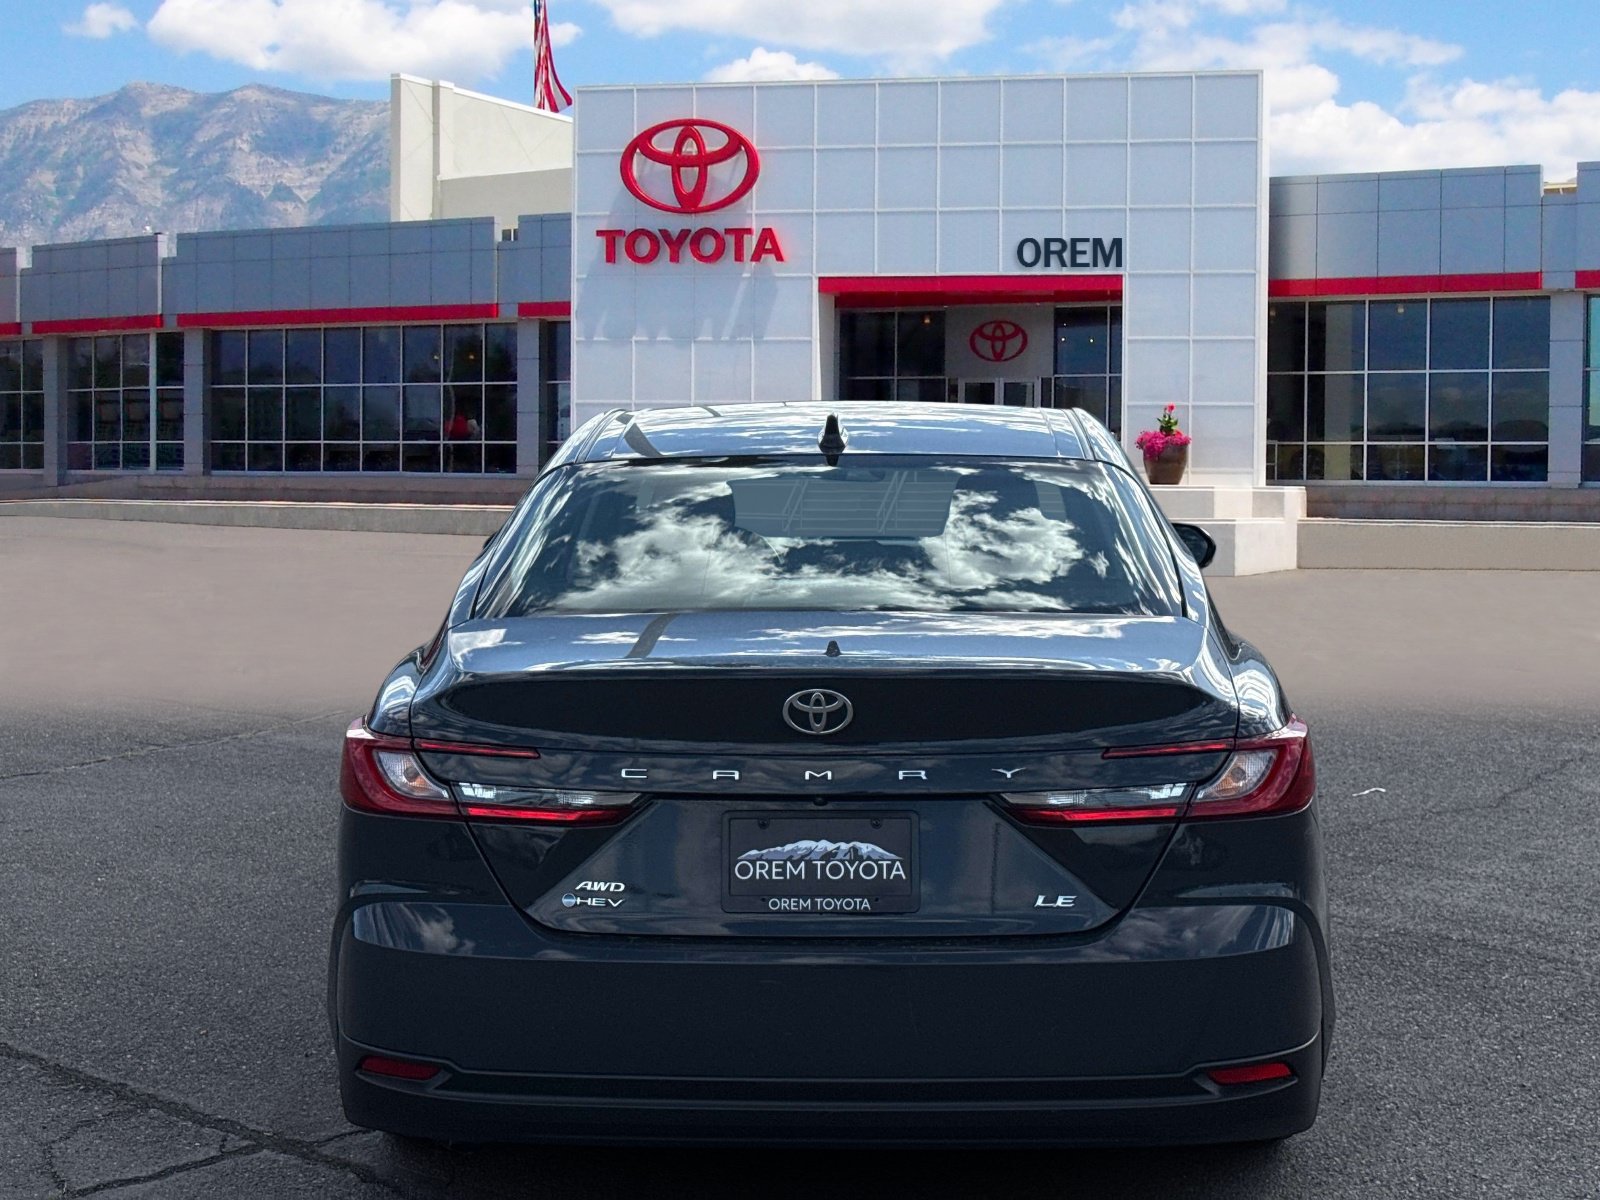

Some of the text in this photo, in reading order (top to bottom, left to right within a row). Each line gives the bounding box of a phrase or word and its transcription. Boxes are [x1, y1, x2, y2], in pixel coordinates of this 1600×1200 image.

[596, 227, 785, 264] TOYOTA
[1016, 238, 1123, 268] OREM
[621, 767, 1025, 781] CAMRY
[734, 860, 906, 880] OREM TOYOTA
[575, 880, 626, 892] AWD
[576, 896, 625, 908] HEV
[768, 898, 871, 911] OREM TOYOTA
[1034, 895, 1077, 907] LE
